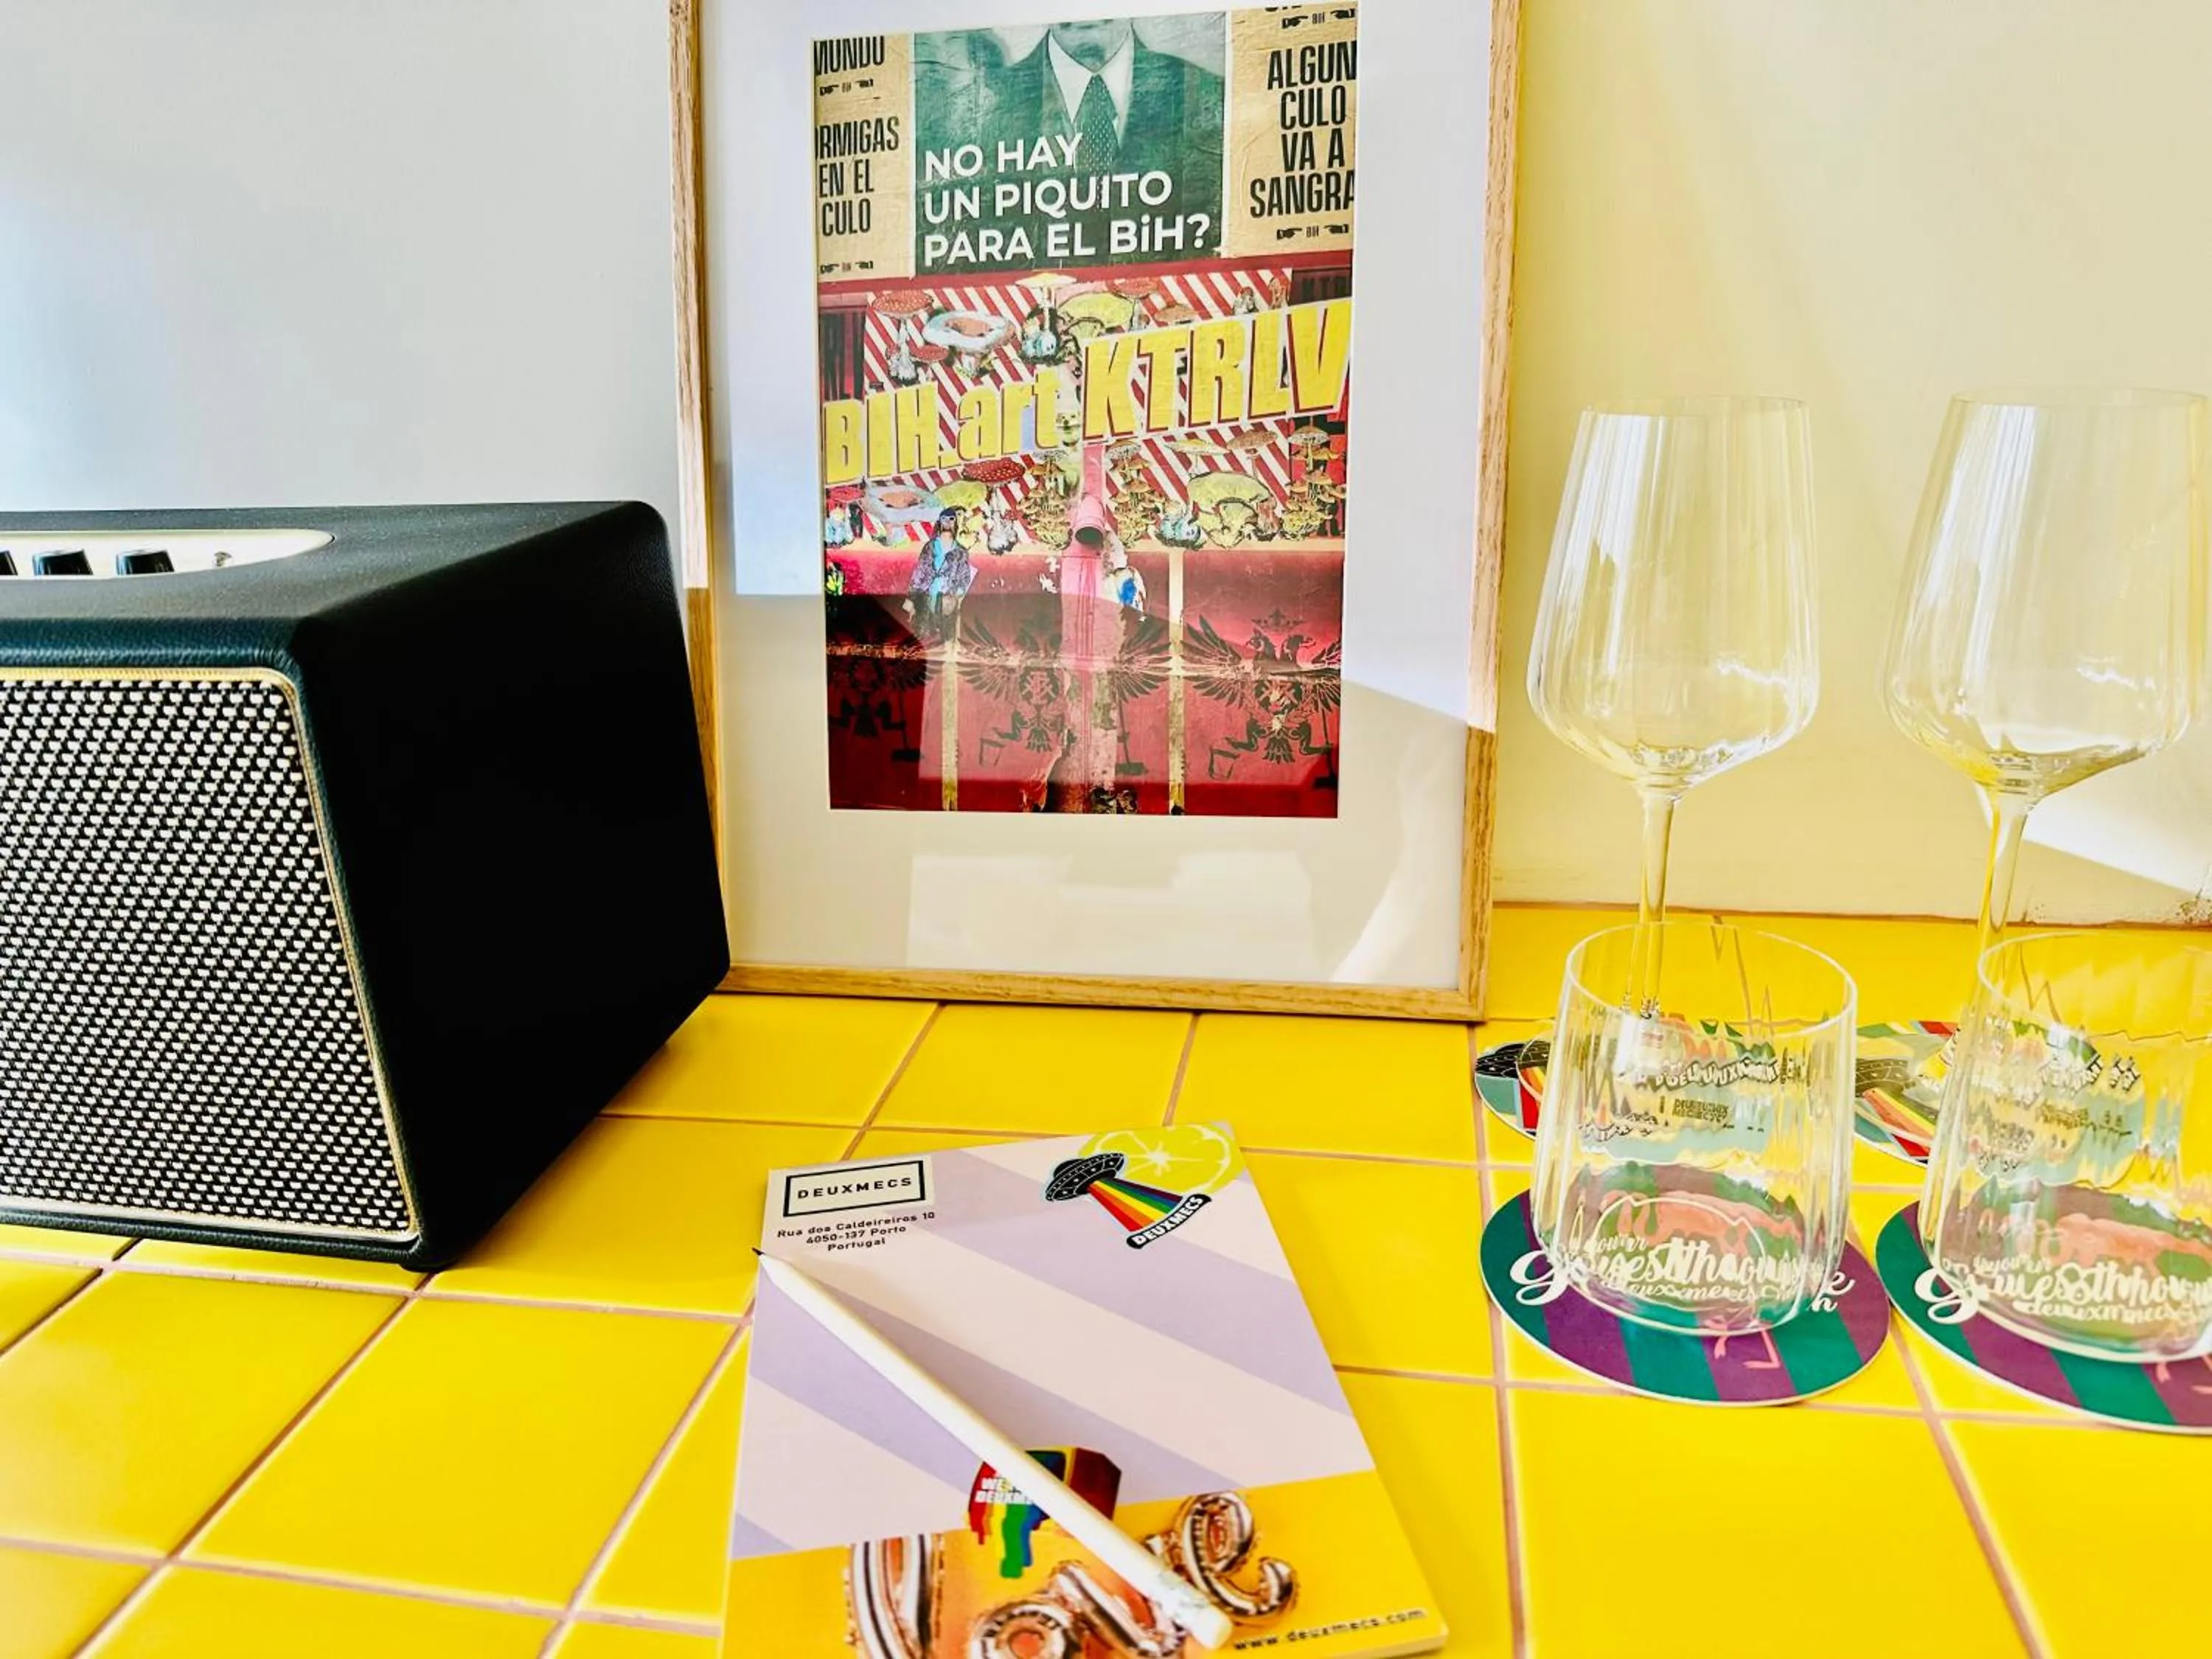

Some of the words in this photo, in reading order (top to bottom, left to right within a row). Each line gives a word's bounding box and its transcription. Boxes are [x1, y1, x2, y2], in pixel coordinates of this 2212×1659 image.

[1281, 85, 1346, 130] CULO
[925, 144, 983, 181] NO
[998, 133, 1082, 173] HAY
[1281, 131, 1316, 173] VA
[1327, 128, 1346, 168] A
[818, 161, 844, 198] EN
[854, 159, 874, 194] EL
[924, 187, 980, 224] UN
[995, 170, 1172, 218] PIQUITO
[822, 198, 872, 237] CULO
[925, 227, 1034, 267] PARA
[1046, 222, 1096, 258] EL
[797, 1178, 912, 1199] DEUXMECS
[777, 1229, 803, 1238] Rua
[807, 1225, 832, 1234] dos
[922, 1211, 936, 1220] 10
[806, 1230, 866, 1245] 4050-137
[870, 1225, 907, 1236] Porto
[1131, 1197, 1203, 1245] DEUXMECS
[827, 1238, 886, 1251] Portugal
